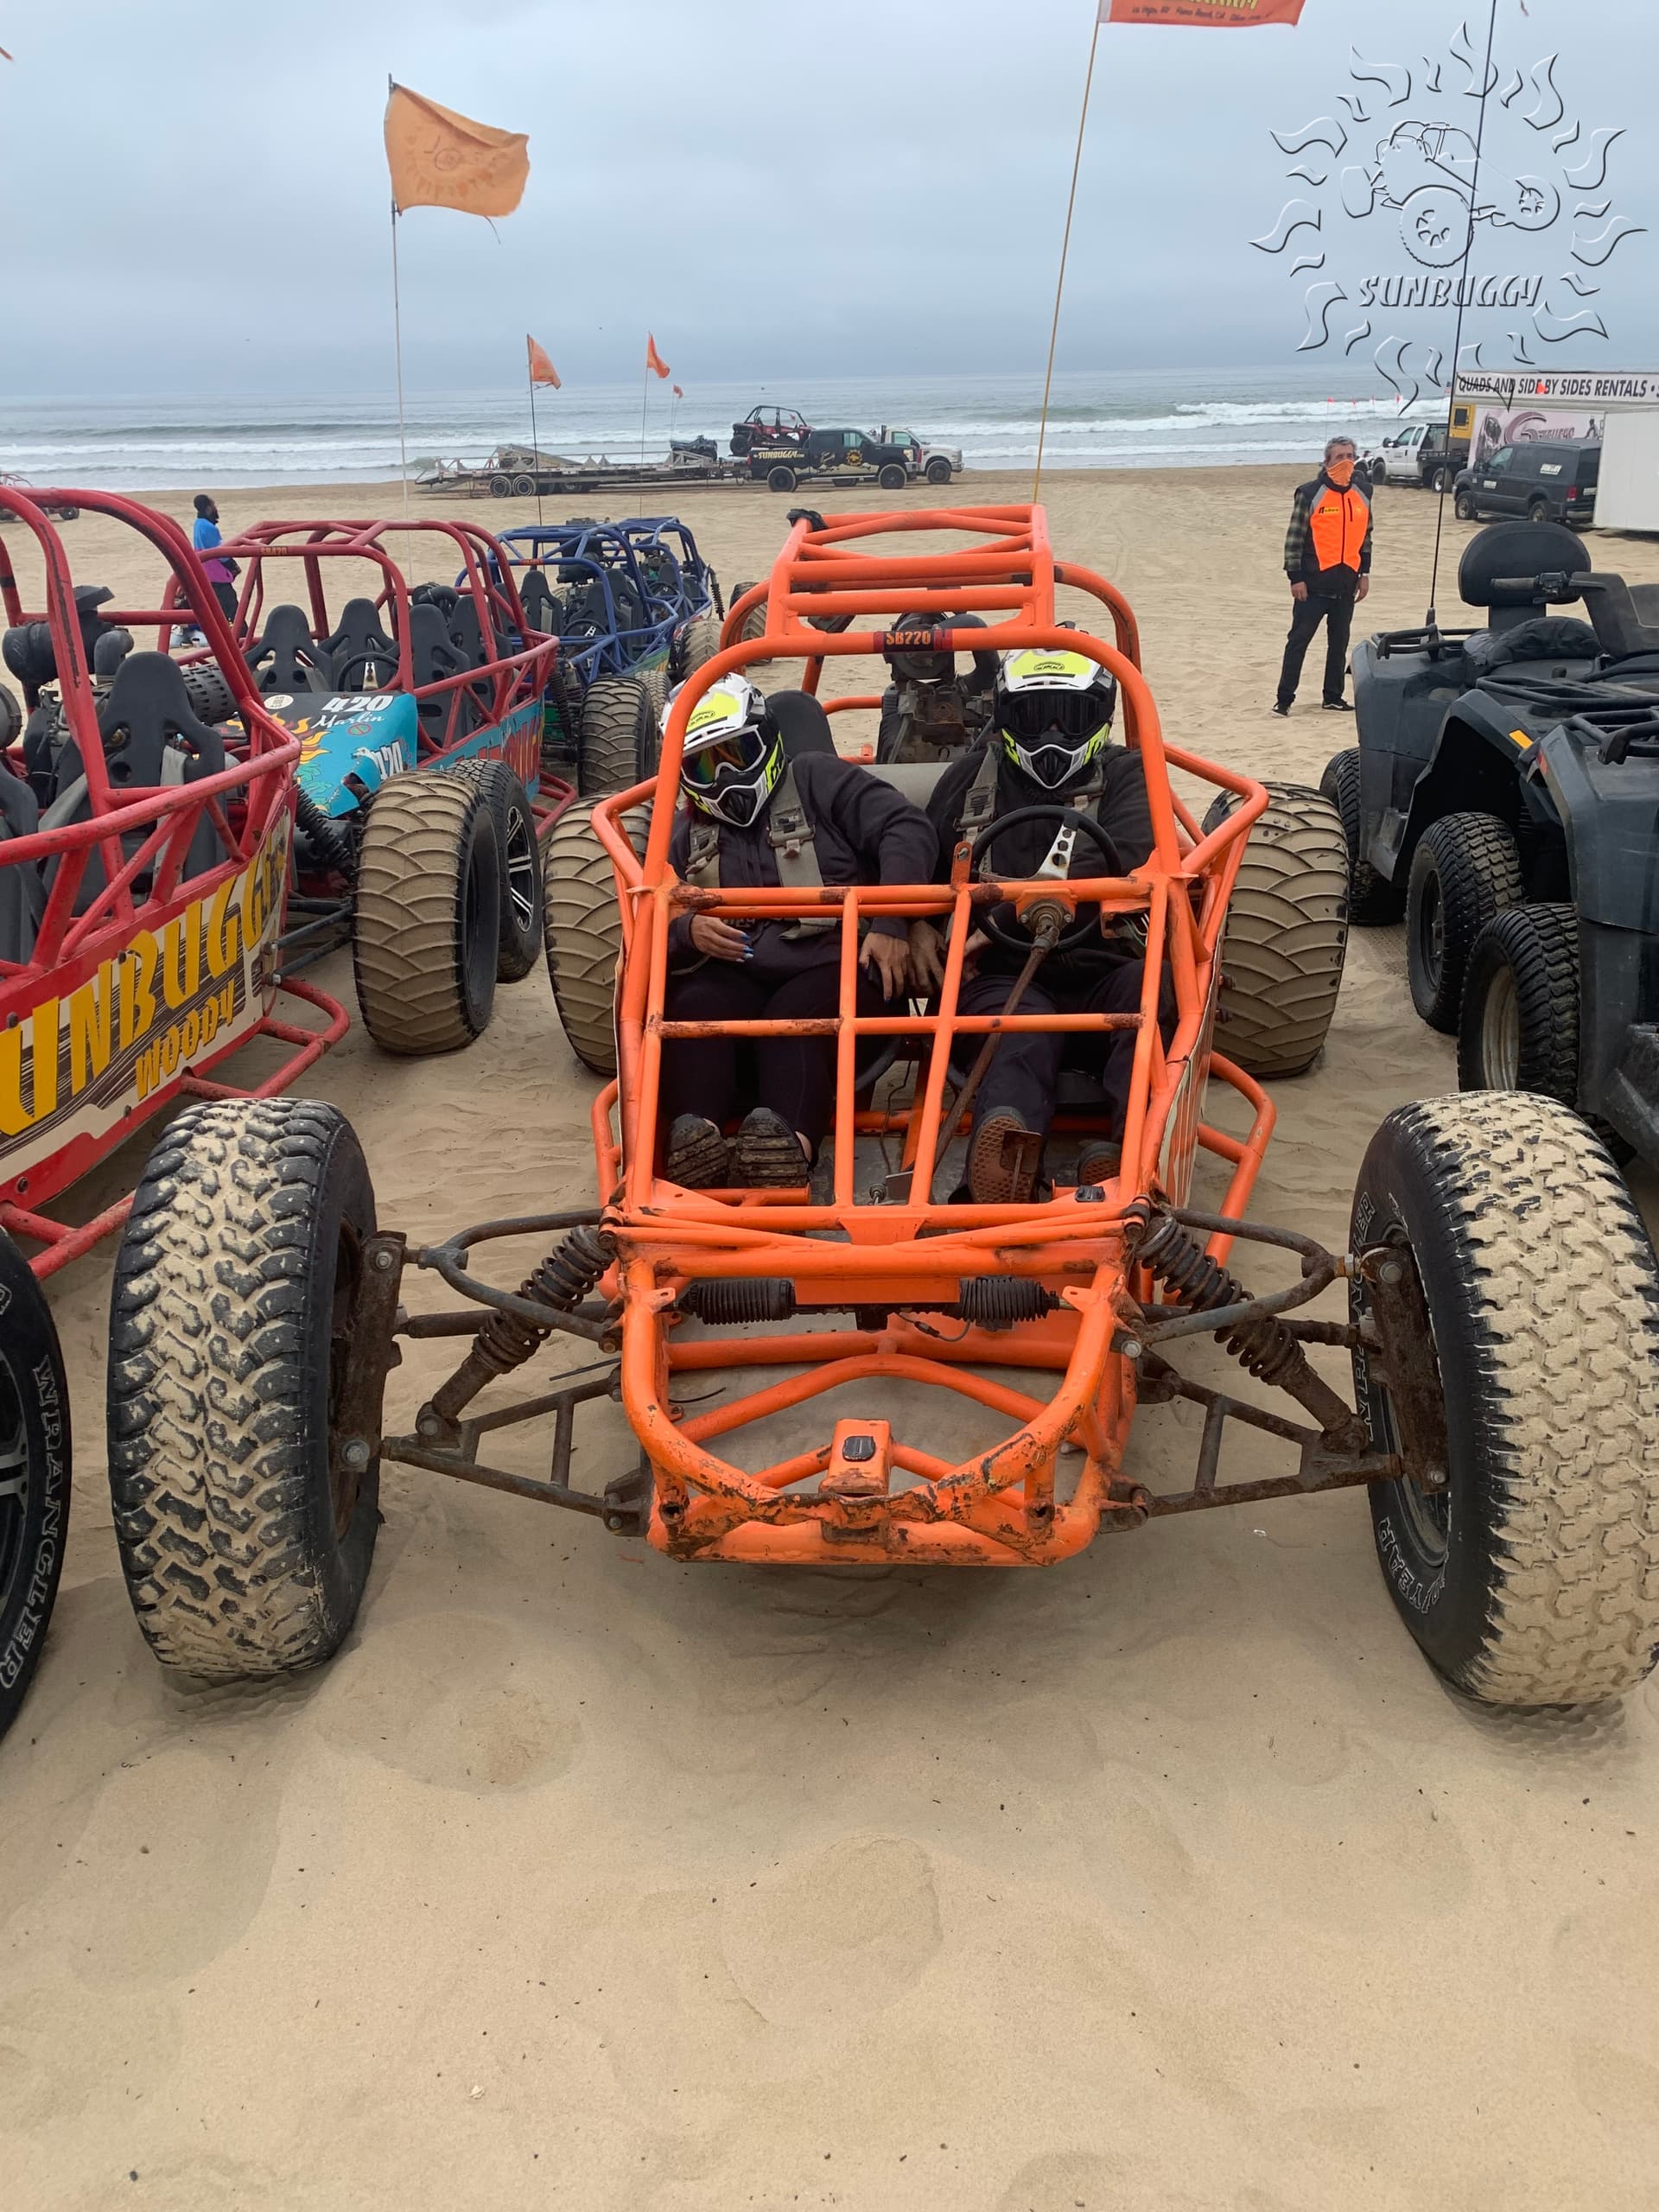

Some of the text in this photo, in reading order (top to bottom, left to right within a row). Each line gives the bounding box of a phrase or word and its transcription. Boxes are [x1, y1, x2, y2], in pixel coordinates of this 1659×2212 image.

[1459, 377, 1492, 393] QUADS
[1492, 378, 1516, 394] AND
[1544, 378, 1559, 395] BY
[1560, 378, 1592, 396] SIDES
[1594, 379, 1648, 397] RENTALS
[321, 695, 394, 712] 420
[311, 711, 386, 728] Marlin
[136, 978, 235, 1102] WOODY
[0, 1354, 64, 1688] WRANGLER
